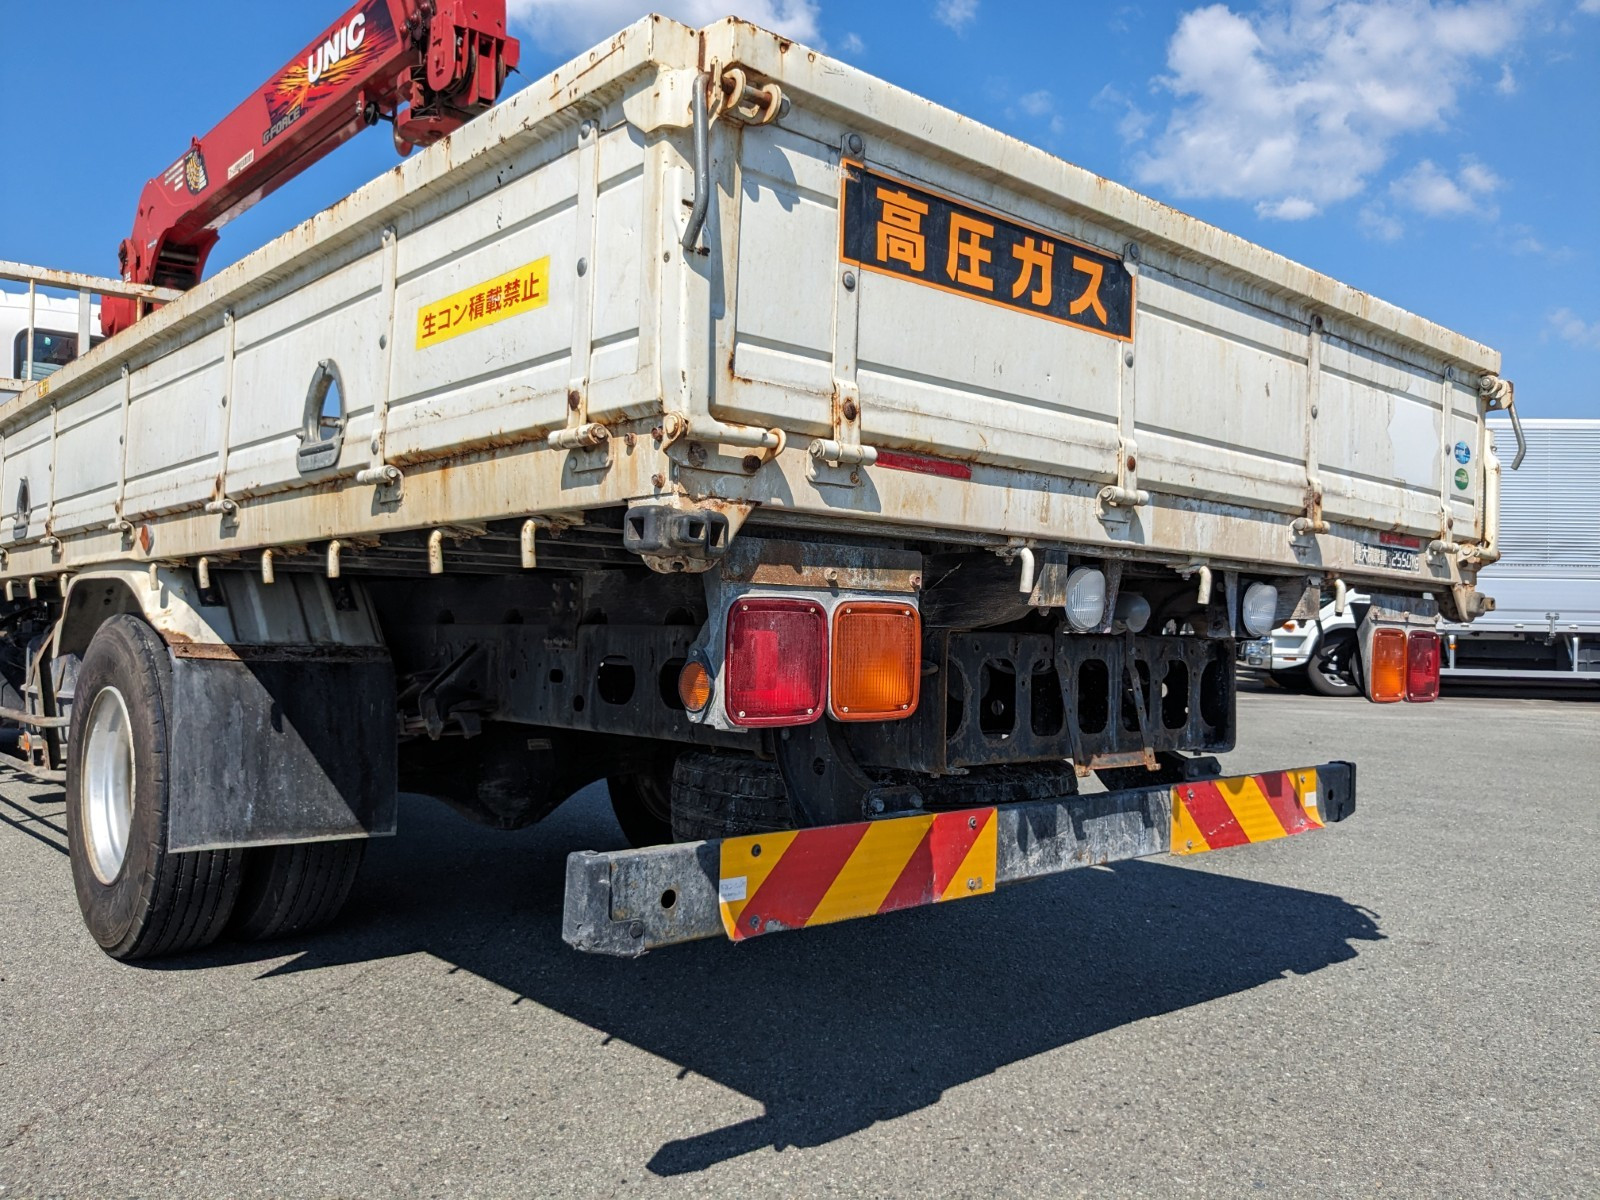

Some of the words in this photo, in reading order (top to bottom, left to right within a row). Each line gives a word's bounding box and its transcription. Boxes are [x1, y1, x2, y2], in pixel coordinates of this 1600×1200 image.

[308, 12, 366, 83] UNIC
[263, 105, 301, 145] G-FORCE
[876, 187, 1107, 326] 高圧ガス
[422, 272, 540, 339] 生コン積載禁止
